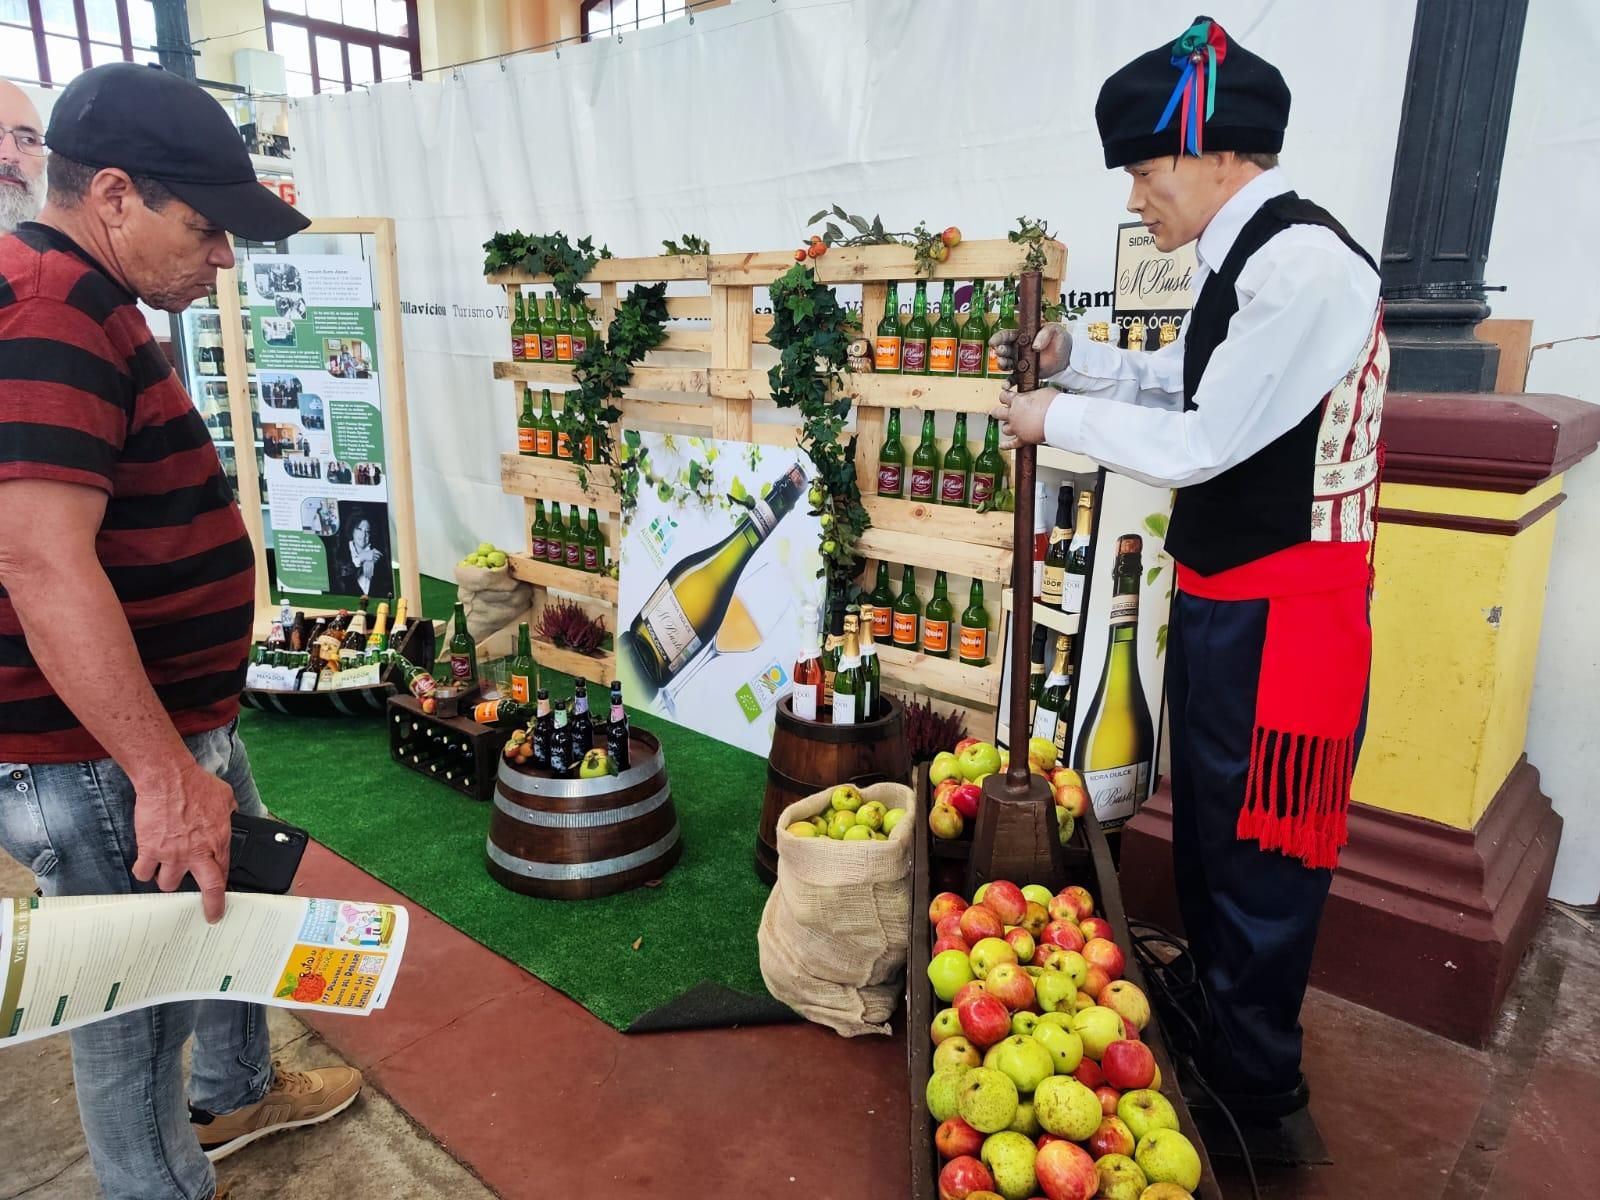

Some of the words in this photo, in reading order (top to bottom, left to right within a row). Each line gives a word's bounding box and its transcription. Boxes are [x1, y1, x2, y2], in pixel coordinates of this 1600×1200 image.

[1128, 235, 1156, 247] SIDRA
[452, 304, 494, 319] Turismo
[13, 771, 22, 779] G
